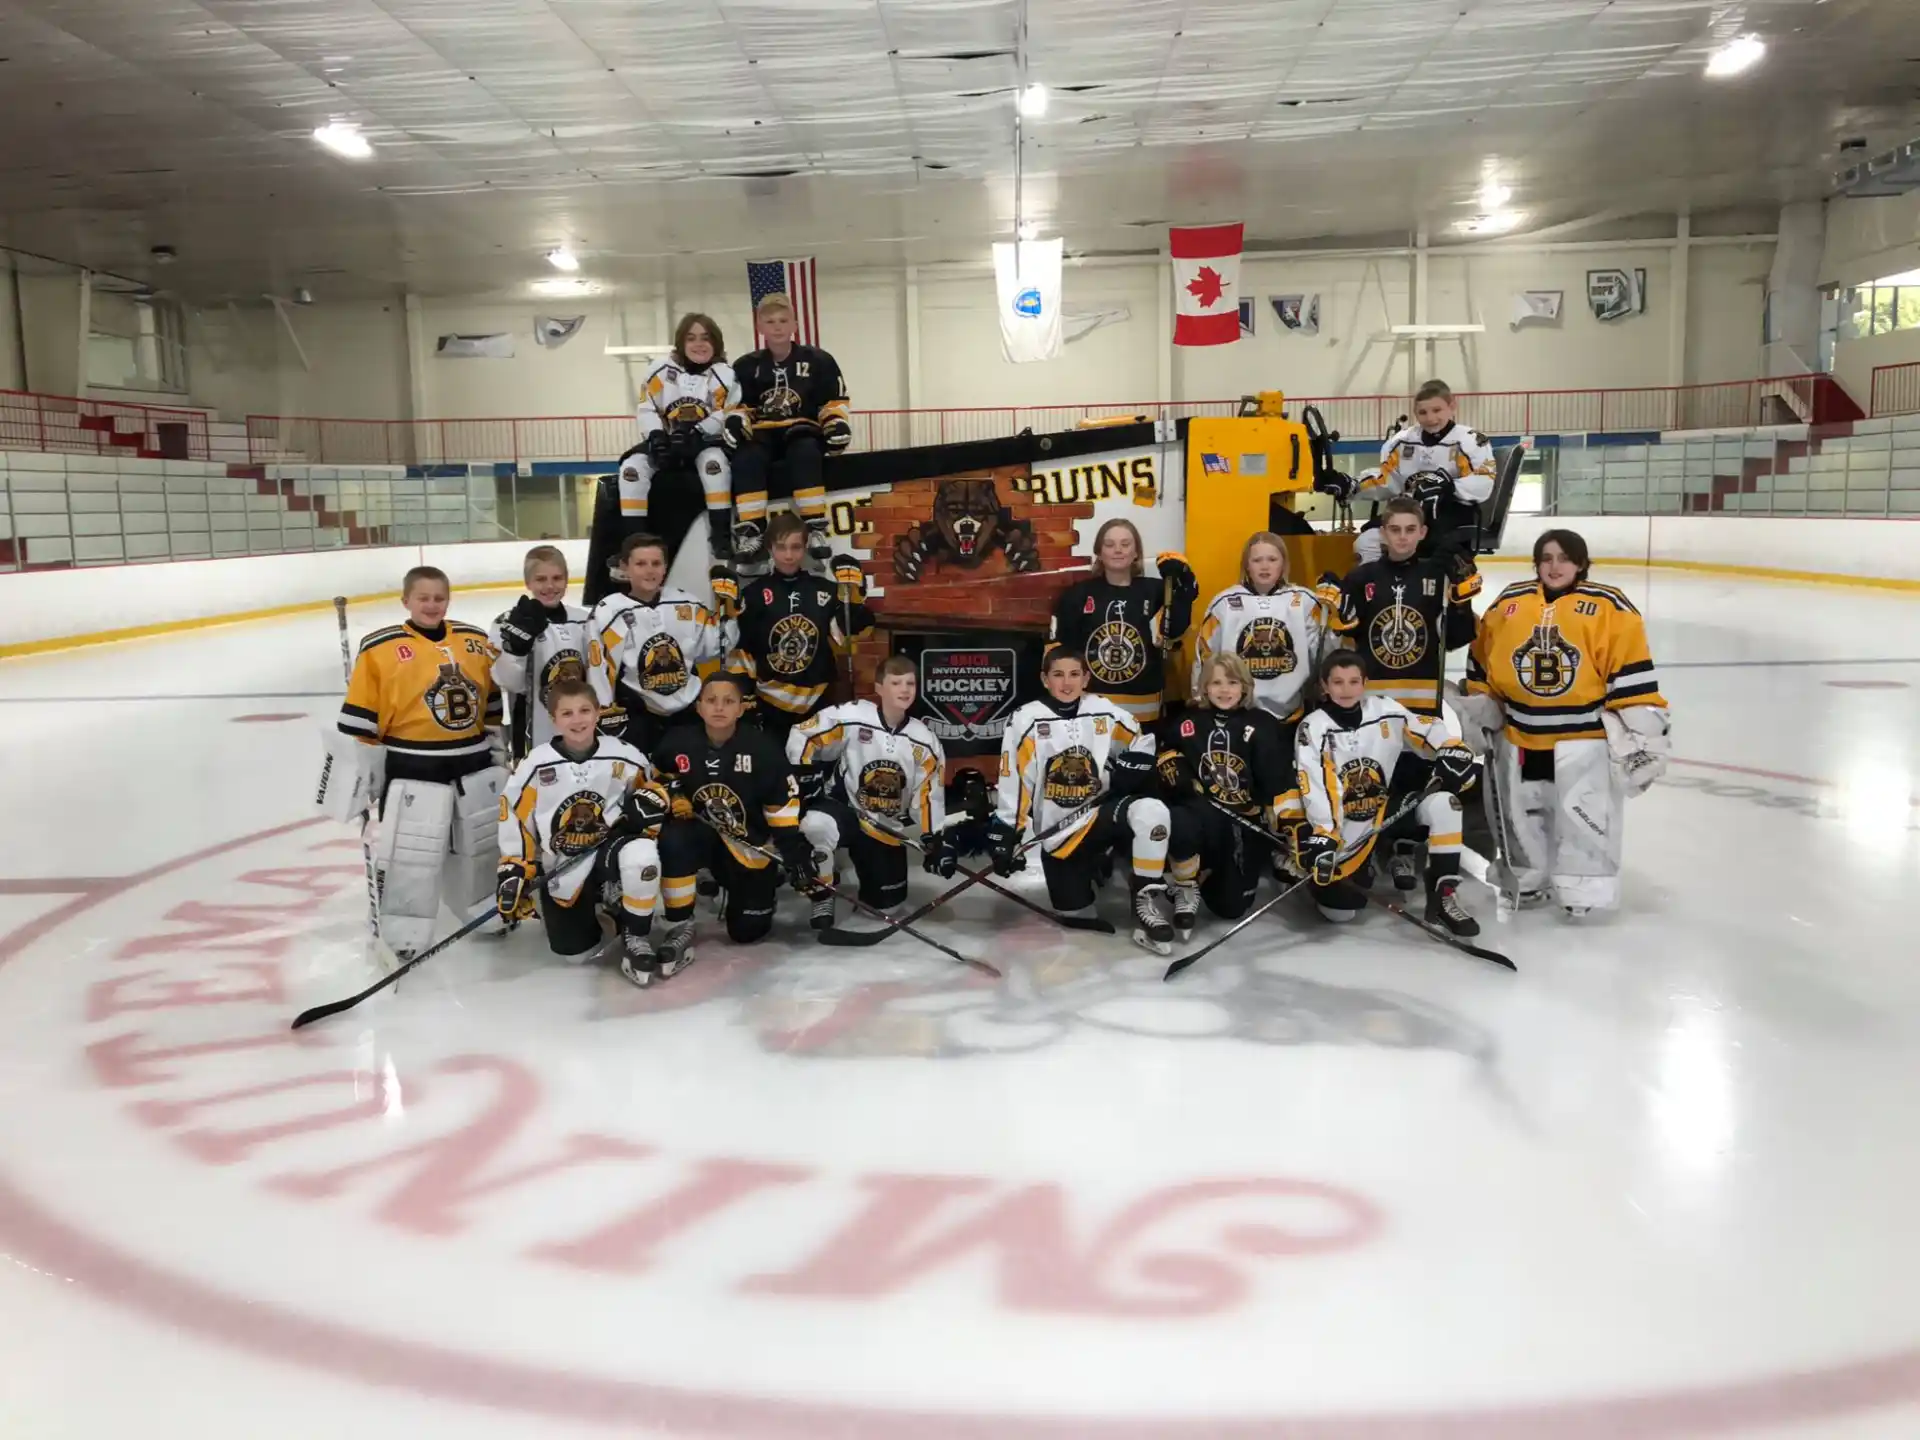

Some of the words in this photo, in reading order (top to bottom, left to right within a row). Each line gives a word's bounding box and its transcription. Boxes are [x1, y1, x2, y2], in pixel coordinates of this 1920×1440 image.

[795, 361, 811, 377] 12
[1421, 577, 1437, 596] 16
[1574, 600, 1599, 616] 30
[464, 638, 485, 656] 35
[1374, 646, 1423, 667] BRUINS
[932, 666, 1005, 674] INVITATIONAL
[1090, 661, 1141, 682] BRUINS
[926, 678, 1011, 693] HOCKEY
[932, 694, 1004, 702] TOURNAMENT
[1115, 758, 1153, 771] RUE
[1571, 805, 1606, 837] BAUER
[84, 840, 1388, 1320] MINUTEMA
